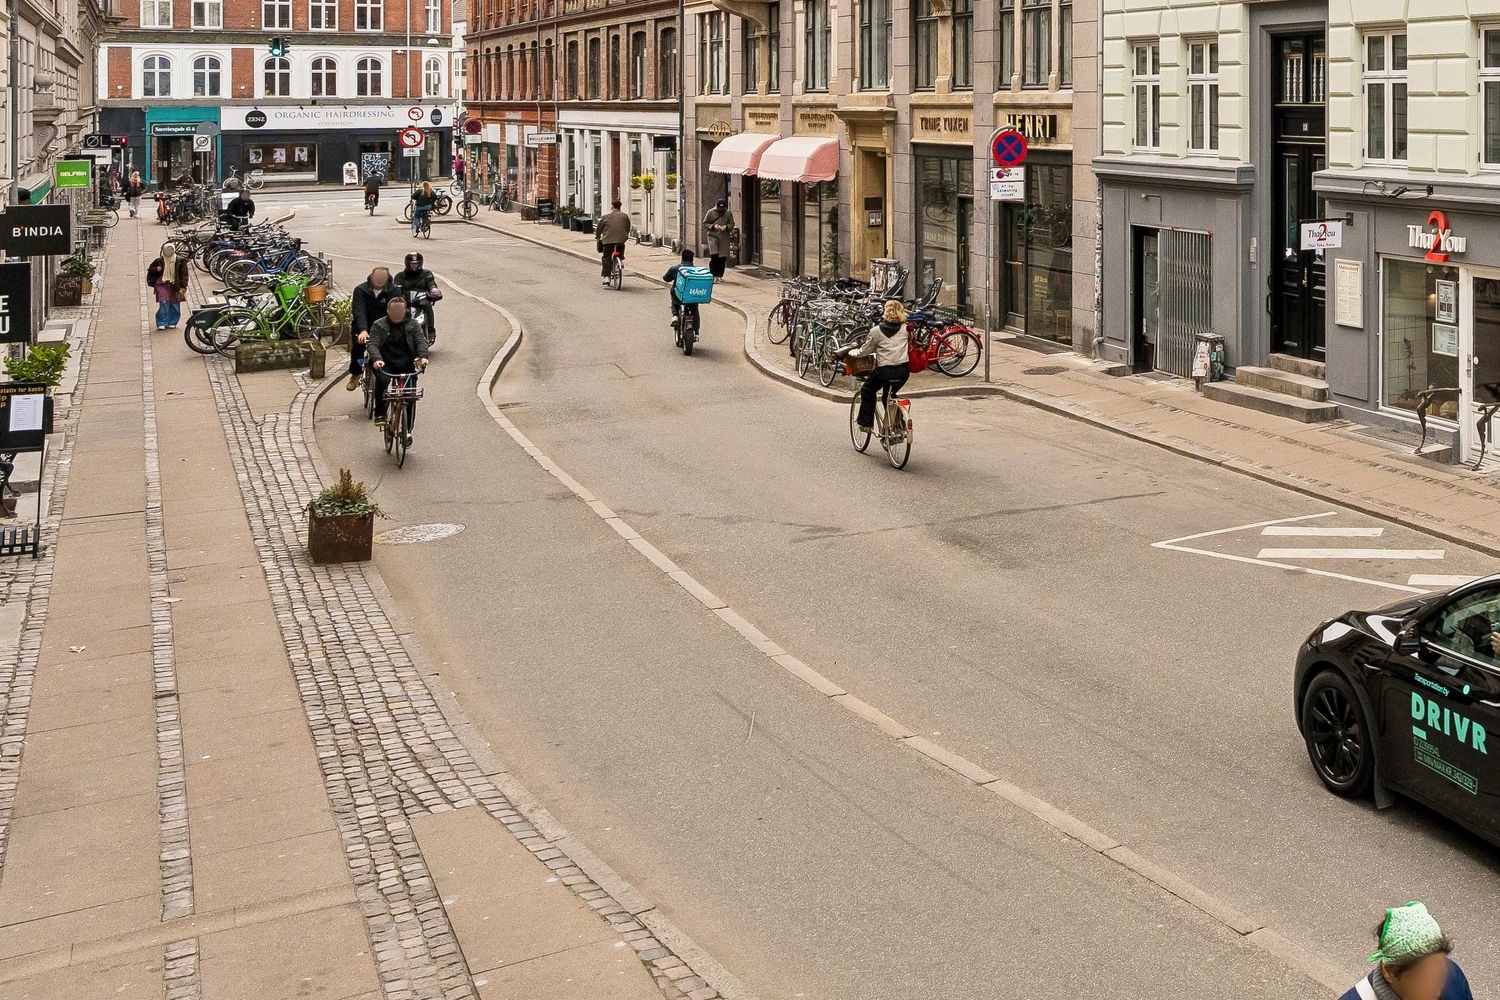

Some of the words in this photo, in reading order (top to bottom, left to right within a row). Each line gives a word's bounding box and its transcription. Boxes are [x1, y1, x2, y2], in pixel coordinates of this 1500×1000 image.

[274, 111, 320, 119] ORGANIC
[325, 110, 395, 118] HAIRDRESSING
[920, 117, 941, 132] TRINE
[942, 117, 969, 132] TUXEN
[86, 135, 109, 147] ØL
[1411, 691, 1488, 755] DRIVR
